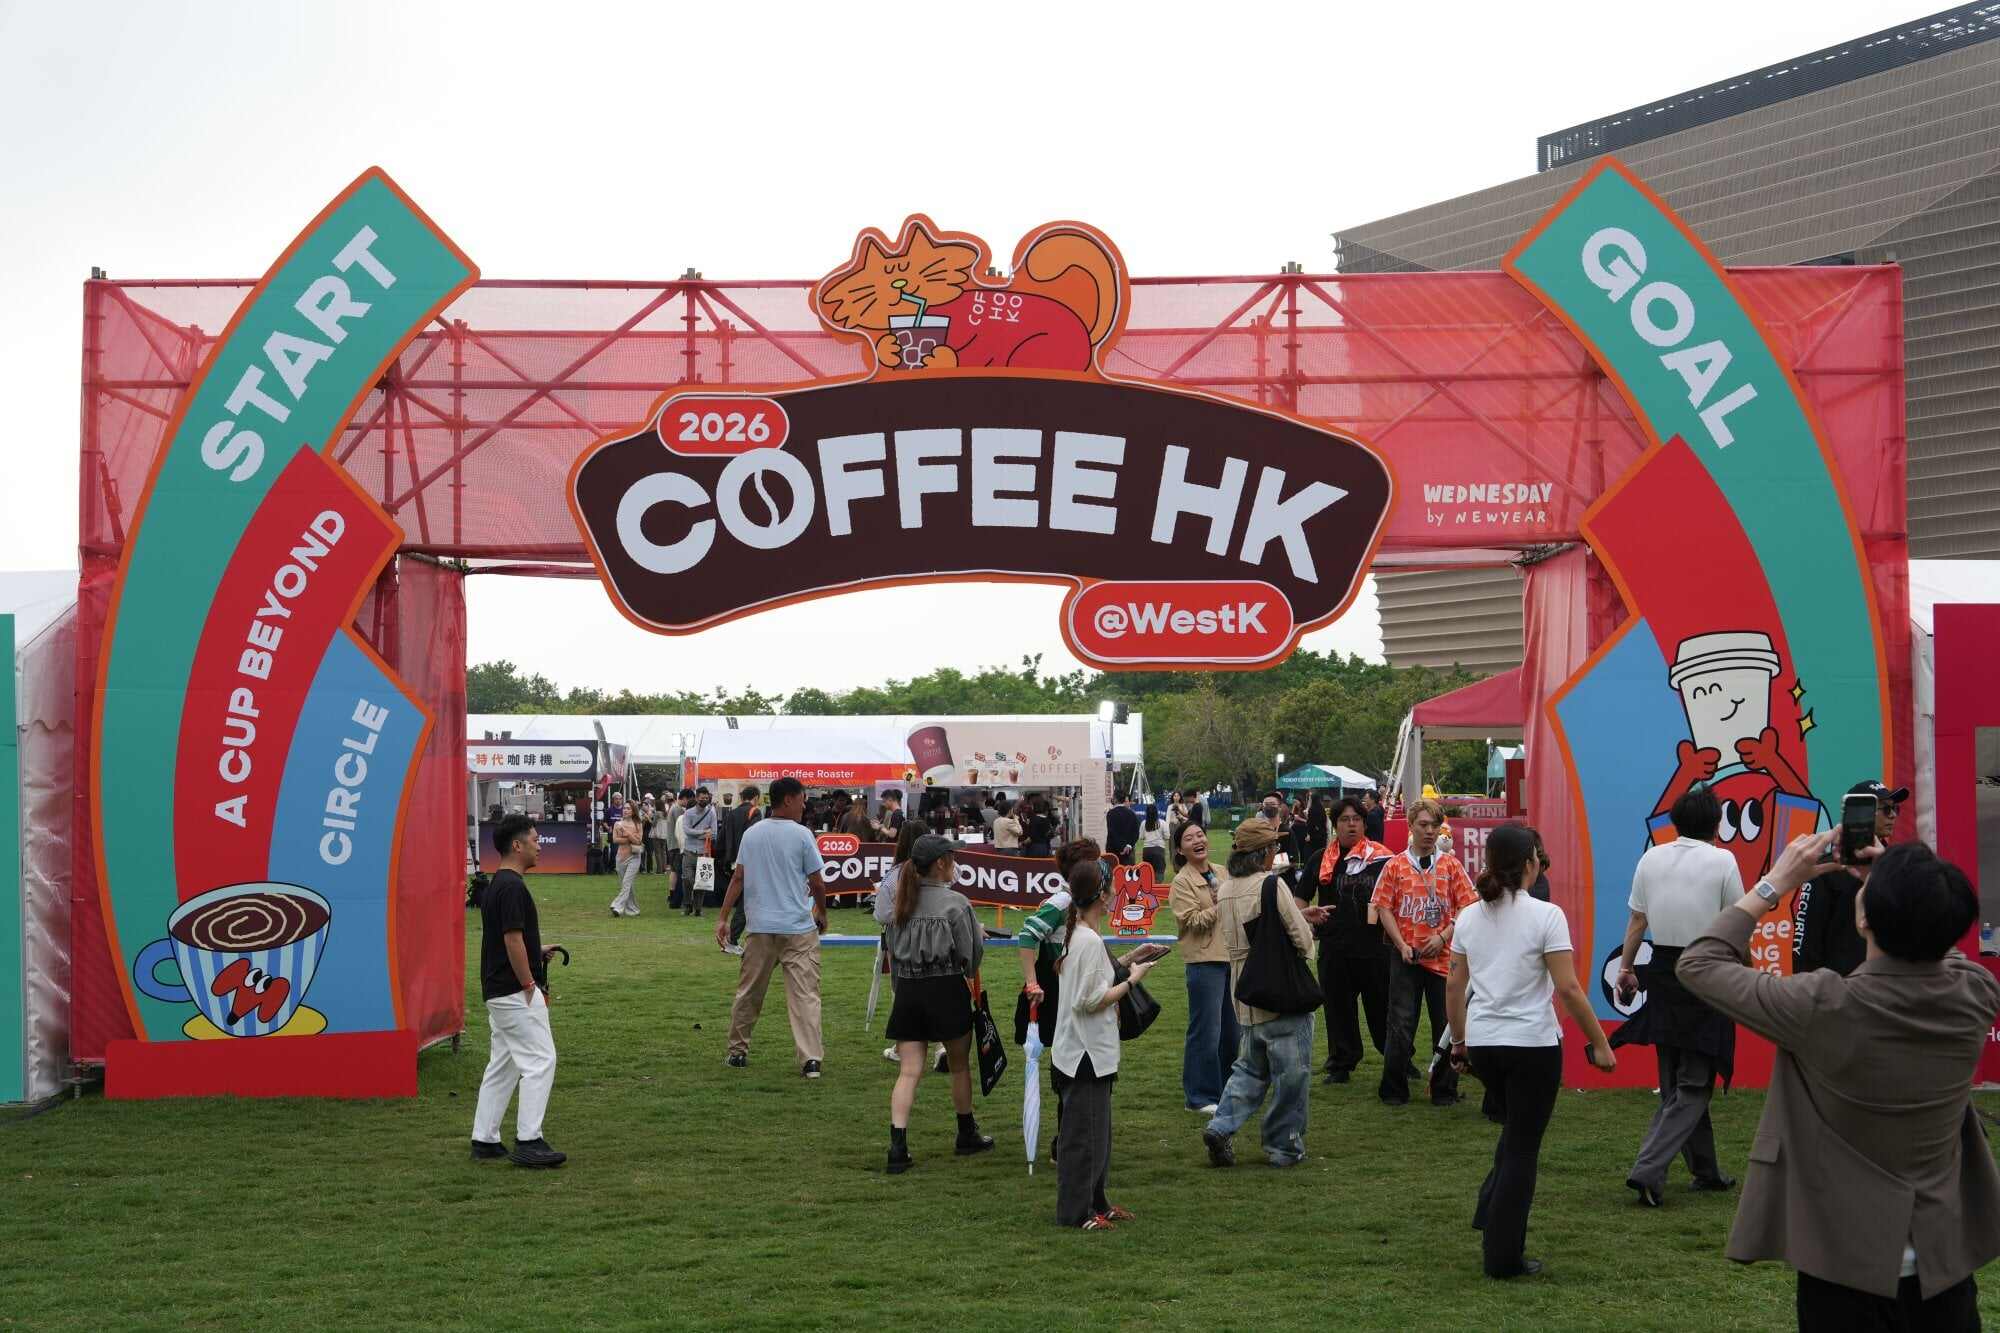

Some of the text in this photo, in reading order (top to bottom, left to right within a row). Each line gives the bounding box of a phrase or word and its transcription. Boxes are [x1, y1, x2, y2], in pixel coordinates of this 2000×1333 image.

[201, 224, 397, 482] START
[1581, 227, 1758, 449] GOAL
[678, 412, 770, 443] 2026
[615, 427, 1349, 585] COFFEE HK
[1423, 482, 1553, 504] WEDNESDAY
[1427, 508, 1444, 527] by
[1093, 601, 1268, 638] @WestK
[215, 510, 346, 828] A CUP BEYOND
[319, 698, 390, 866] CIRCLE
[749, 769, 855, 778] Urban Coffee Roaster
[822, 841, 853, 851] 2026
[820, 856, 1066, 894] COFF ONG KO
[1792, 882, 1812, 956] SECURITY
